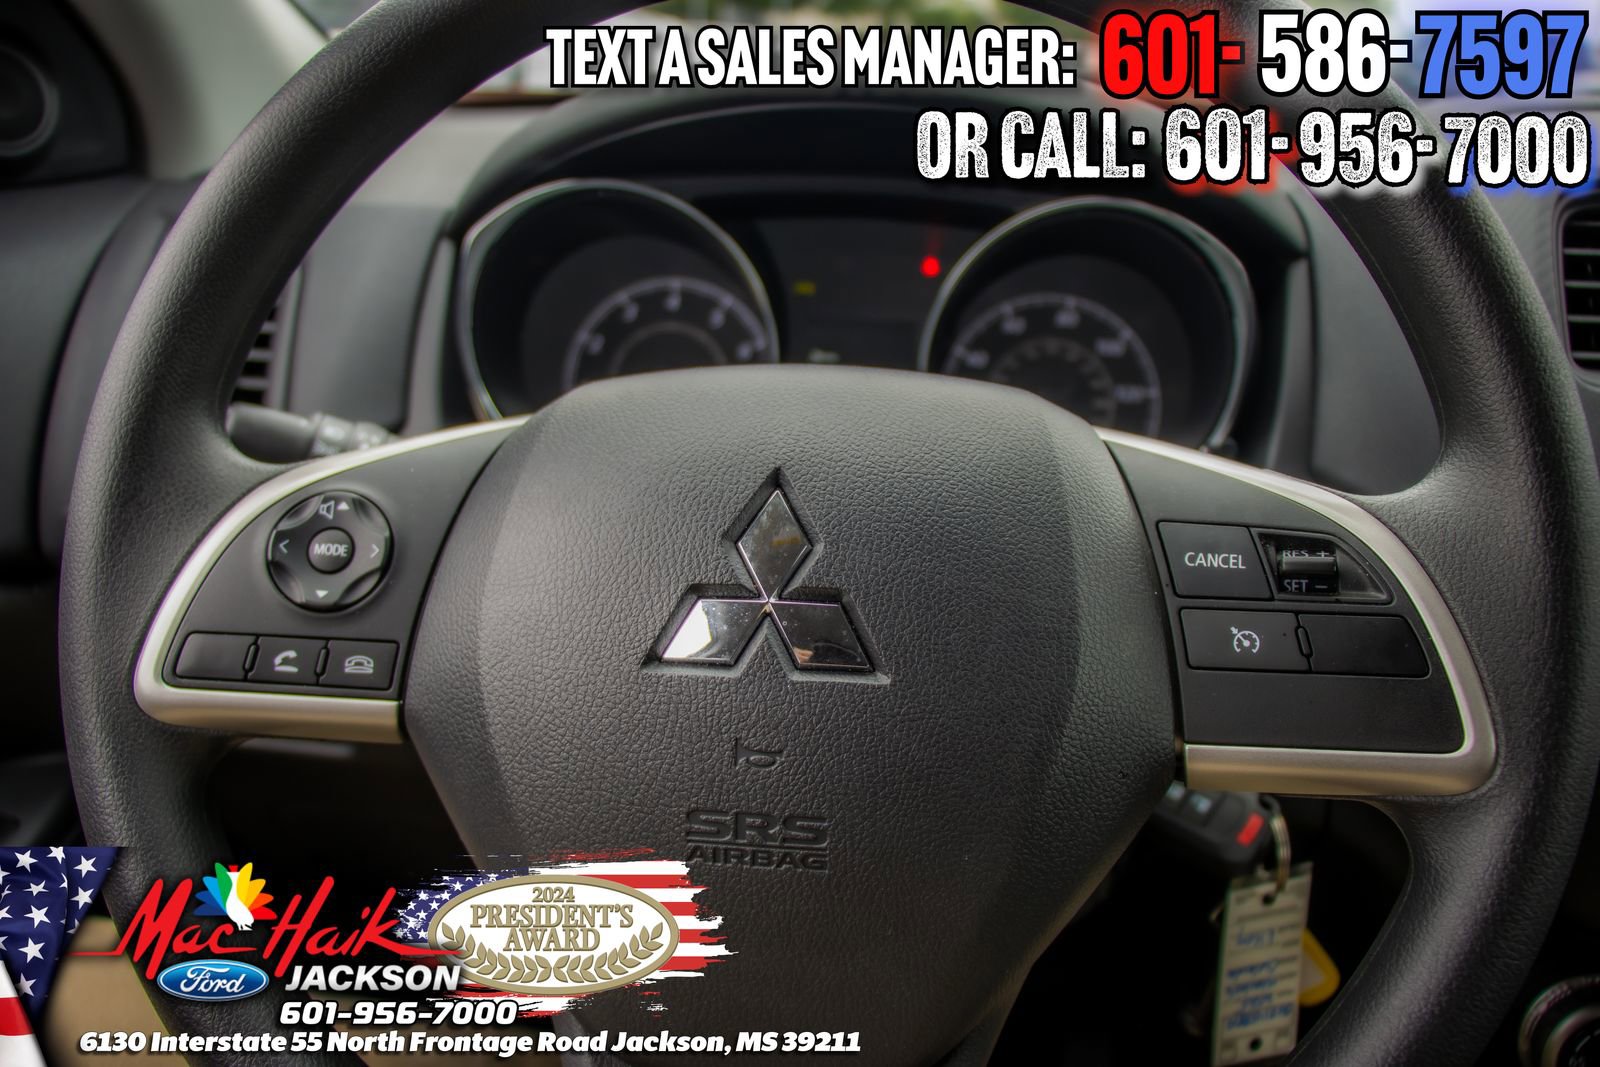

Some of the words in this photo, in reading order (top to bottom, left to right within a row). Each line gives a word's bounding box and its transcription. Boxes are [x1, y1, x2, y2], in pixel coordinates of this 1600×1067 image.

[313, 543, 348, 556] MODE
[1184, 552, 1246, 569] CANCEL
[1283, 579, 1308, 593] SET
[686, 810, 830, 848] SRS
[686, 848, 829, 872] AIRBAG
